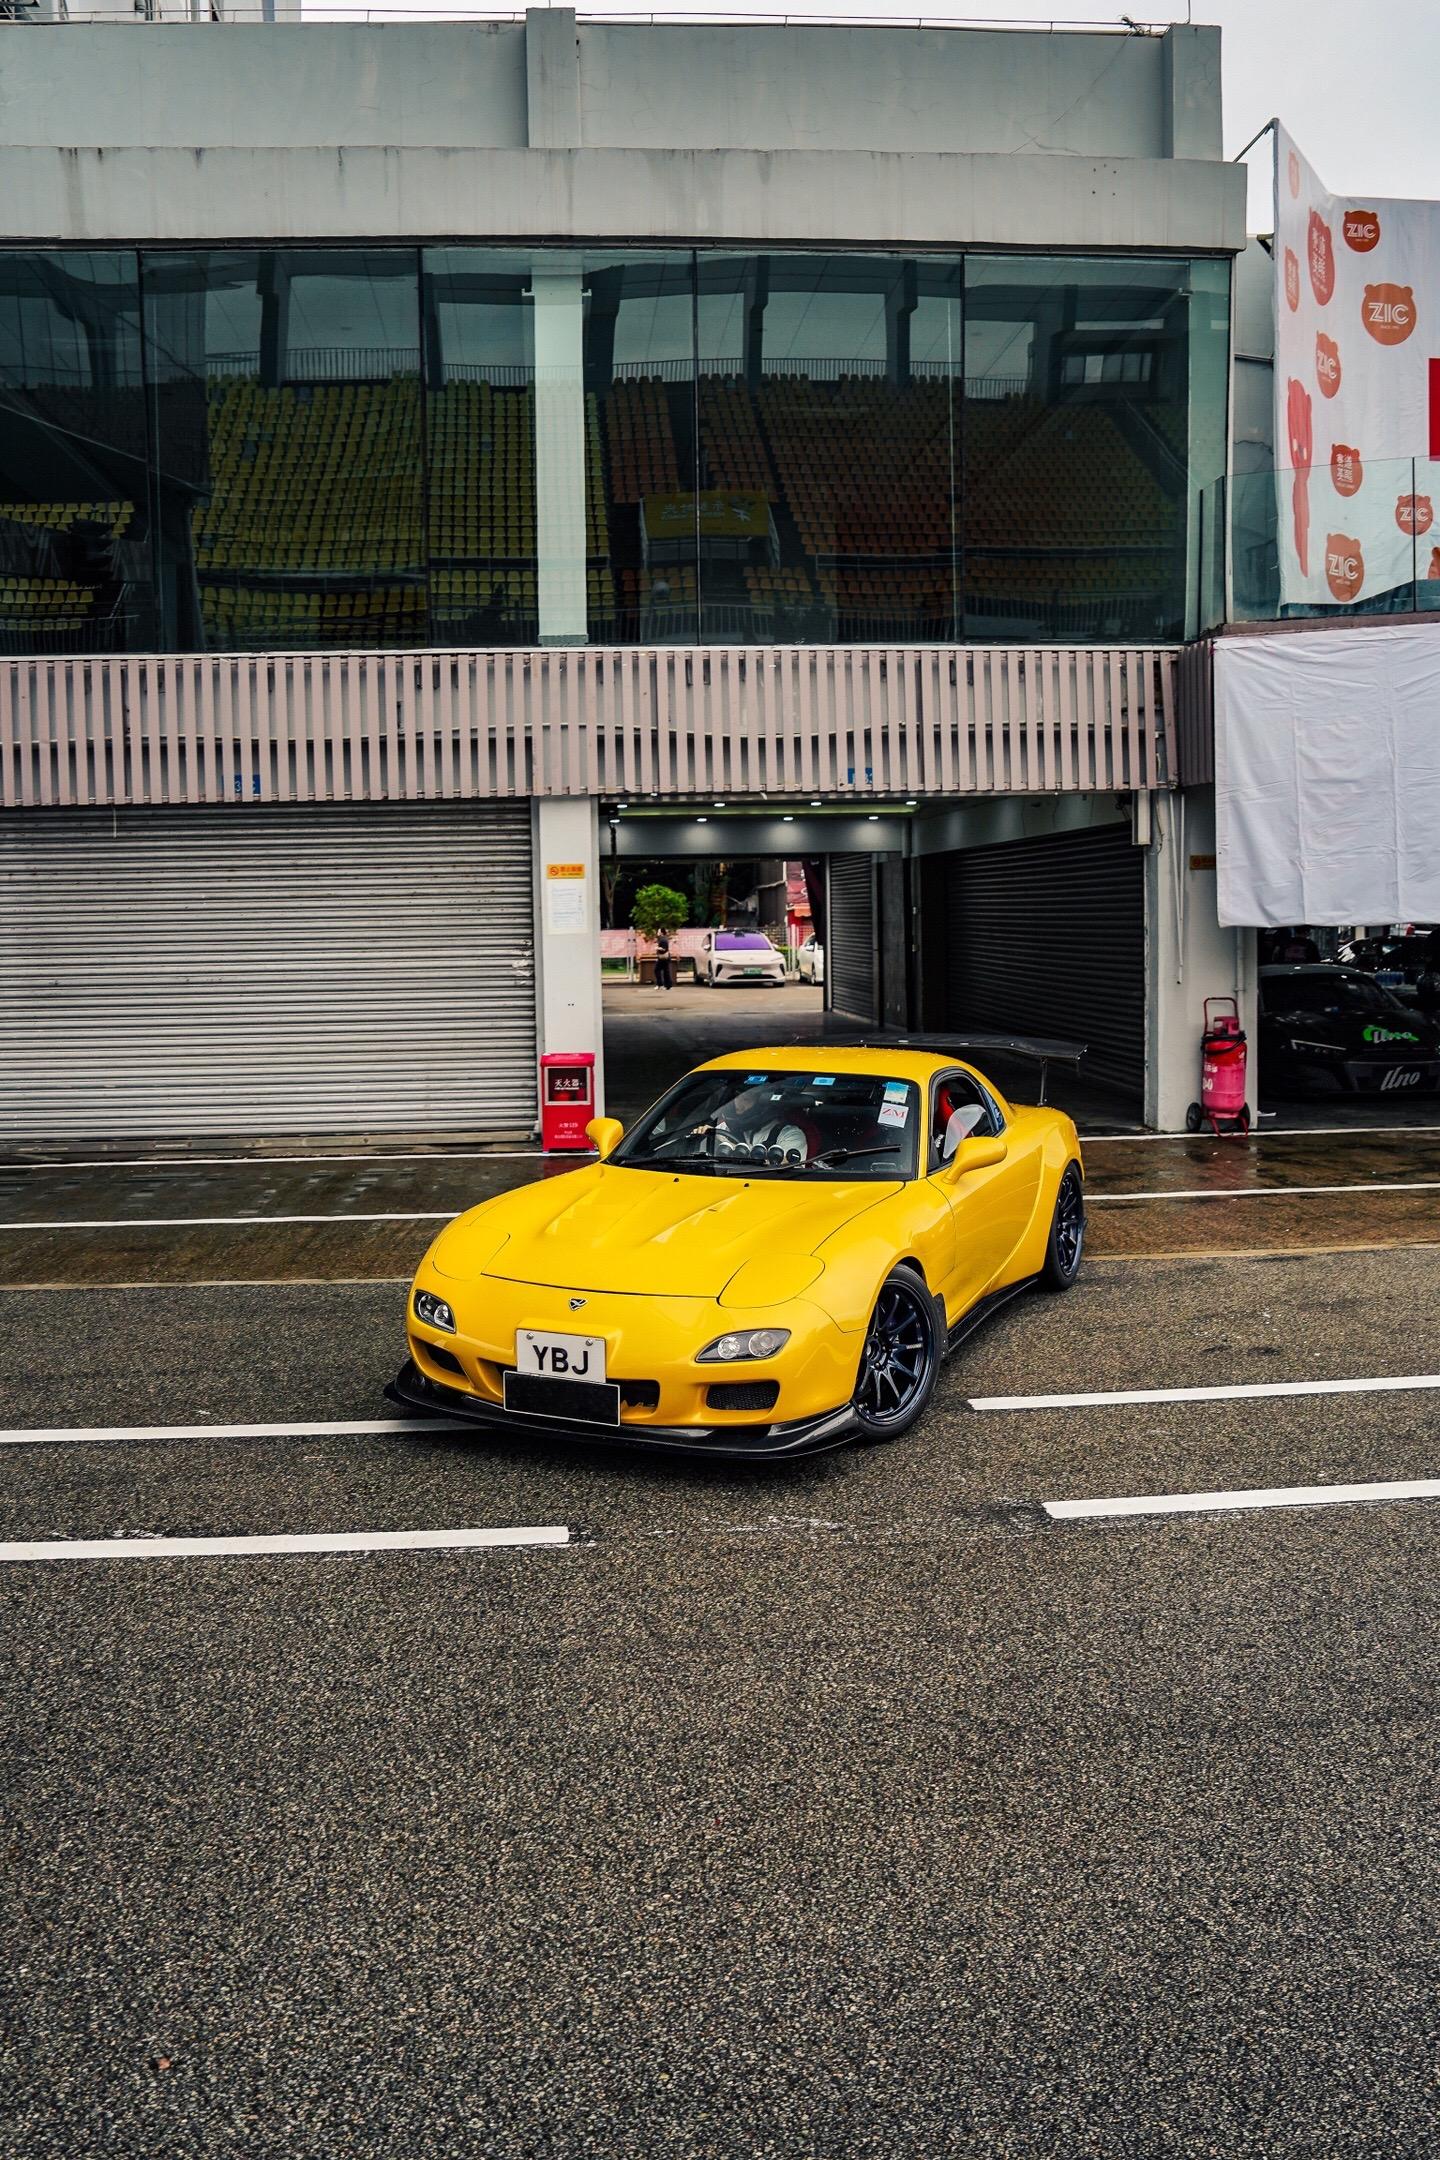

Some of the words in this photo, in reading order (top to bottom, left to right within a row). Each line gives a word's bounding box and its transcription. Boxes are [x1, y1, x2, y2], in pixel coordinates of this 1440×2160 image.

[1346, 223, 1375, 238] ZIC
[1368, 302, 1409, 325] ZIC
[1317, 351, 1336, 379] ZIC
[1328, 554, 1358, 579] ZIC
[1380, 1066, 1420, 1090] Uno
[532, 1345, 589, 1375] YBJ
